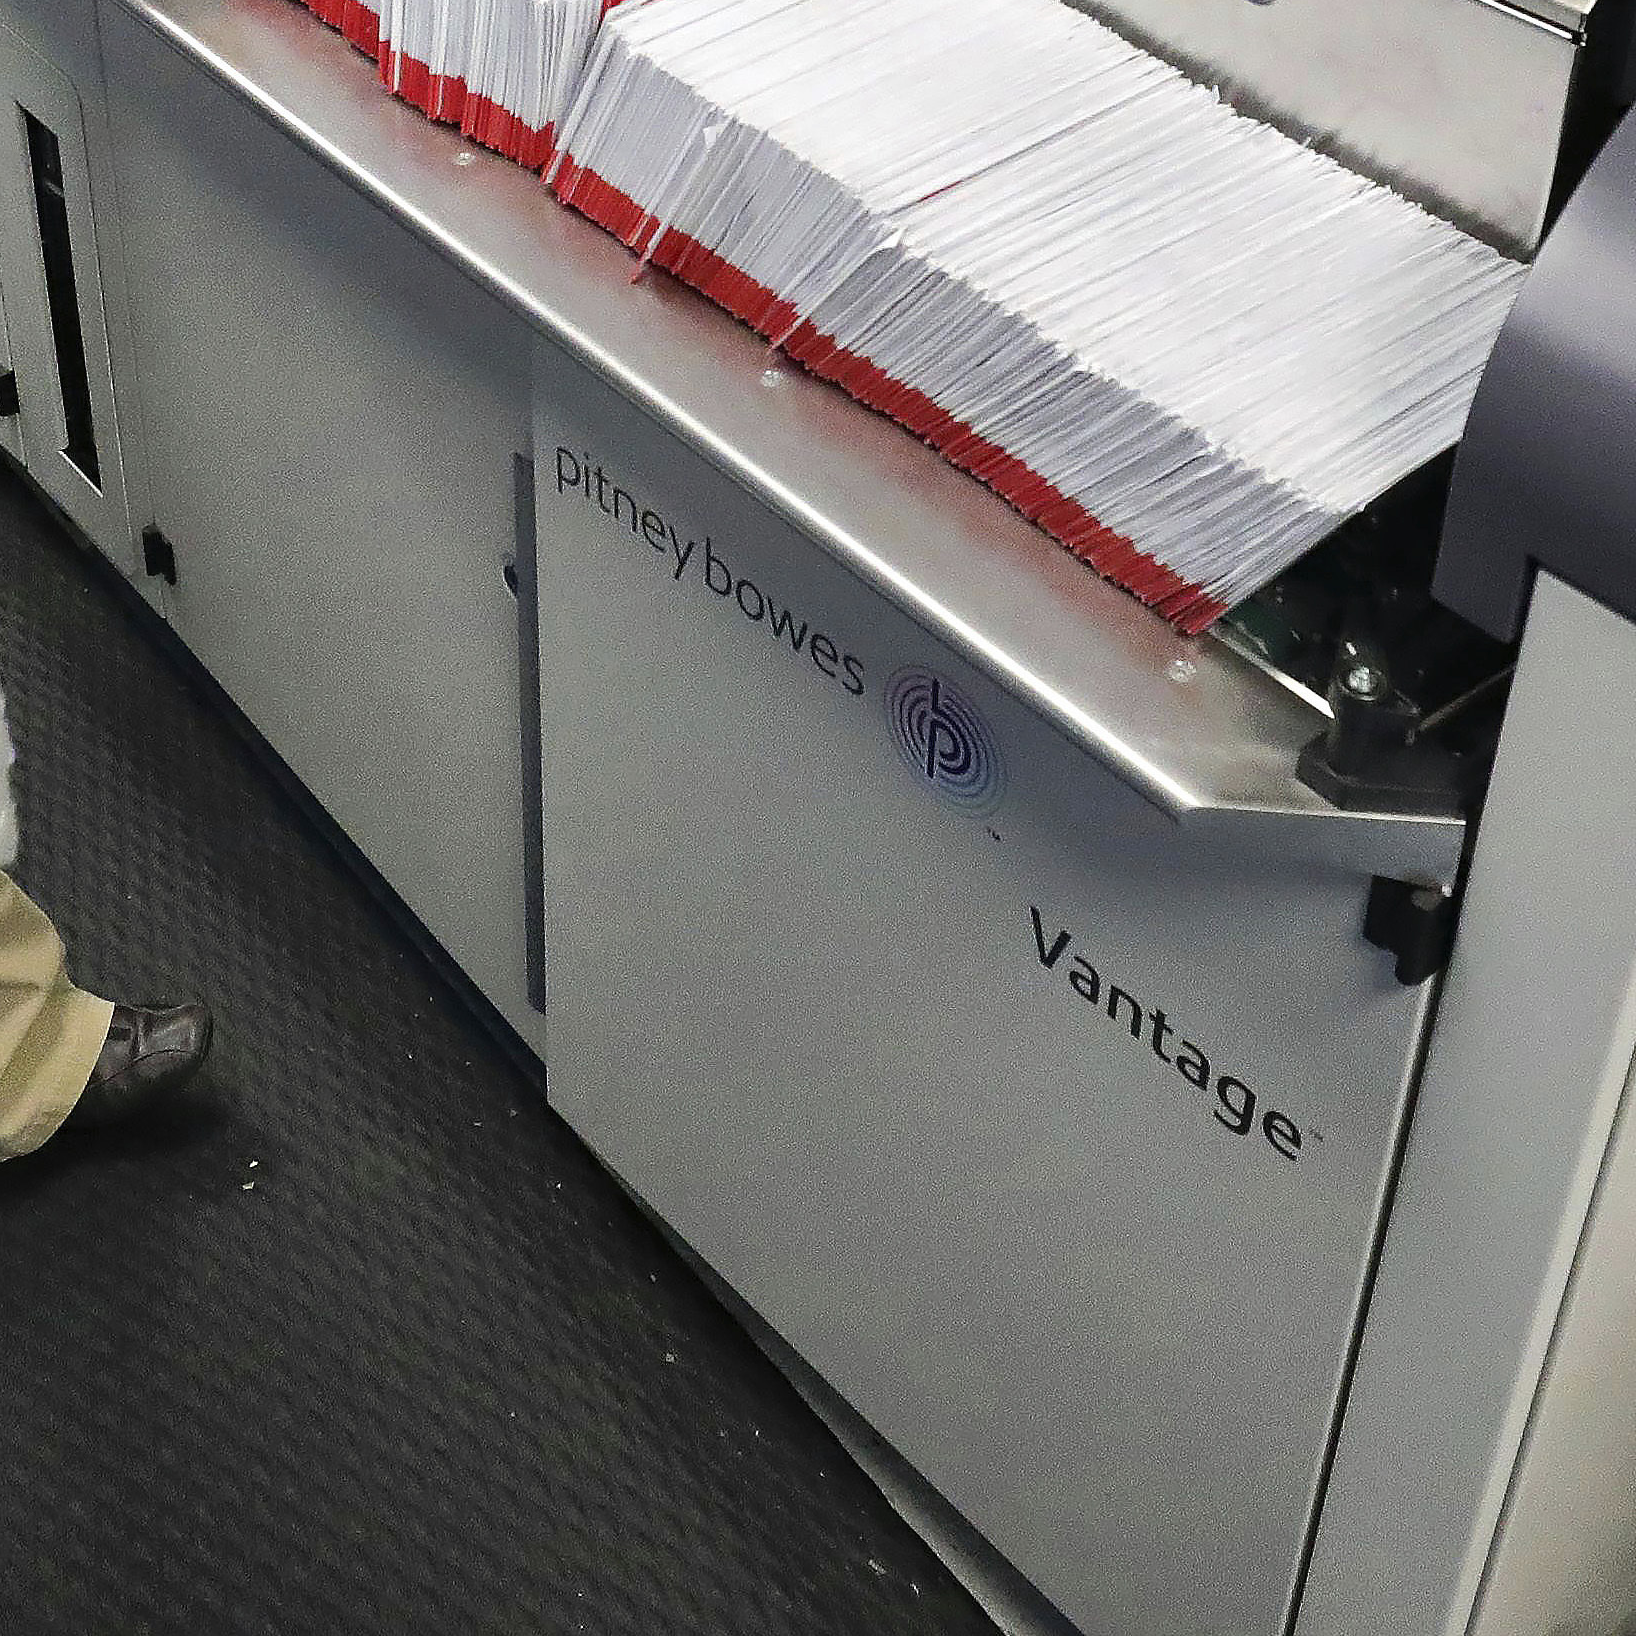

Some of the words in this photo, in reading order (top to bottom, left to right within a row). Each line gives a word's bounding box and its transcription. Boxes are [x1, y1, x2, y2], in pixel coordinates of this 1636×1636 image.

[553, 447, 692, 582] pitney
[705, 538, 867, 697] bowes
[1030, 906, 1304, 1162] Vantage
